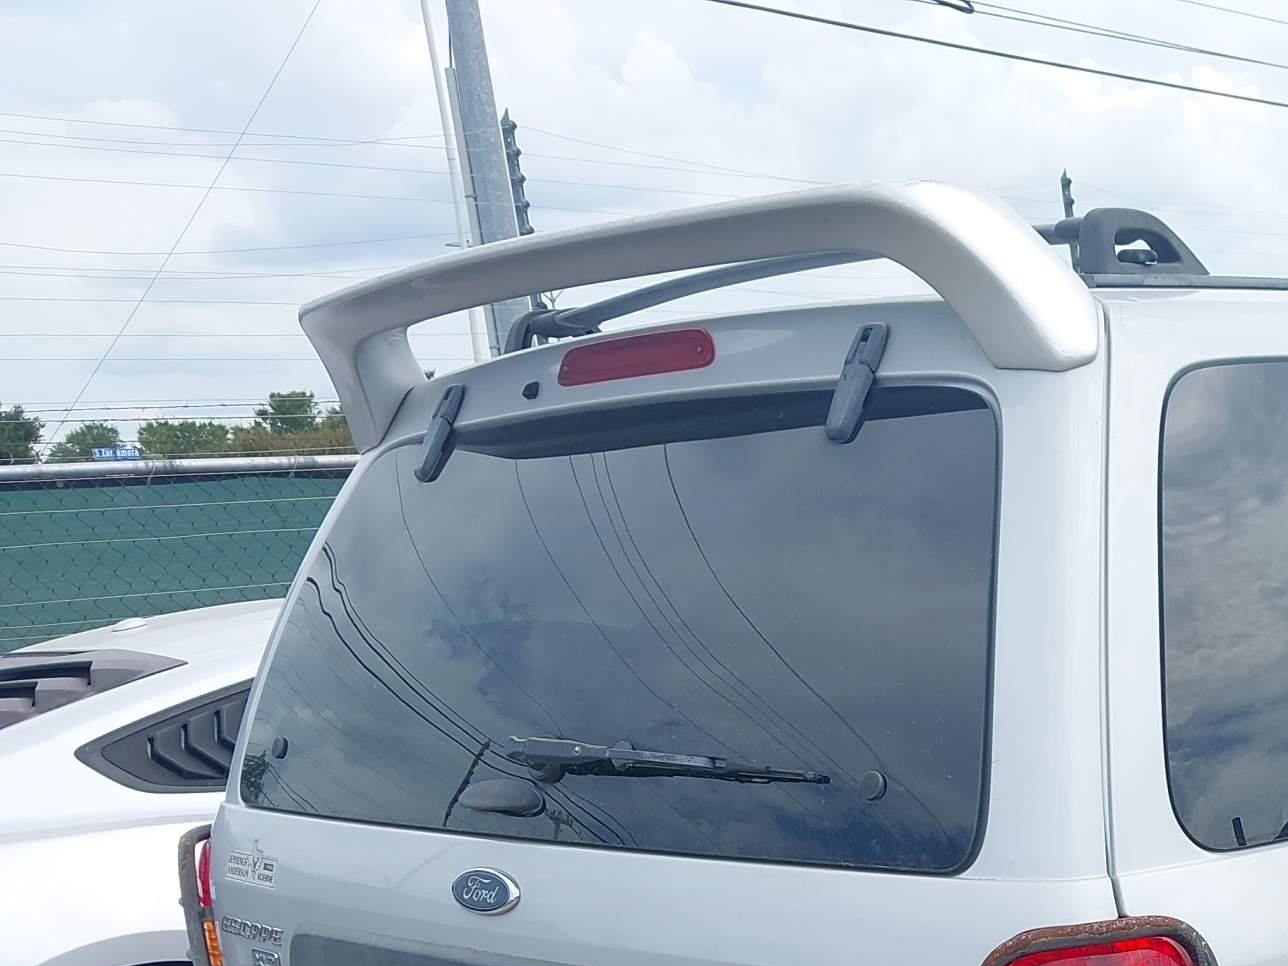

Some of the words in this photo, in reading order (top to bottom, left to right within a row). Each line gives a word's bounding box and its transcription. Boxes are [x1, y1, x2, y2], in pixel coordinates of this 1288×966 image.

[101, 448, 140, 457] Zaramora
[462, 875, 500, 904] Ford
[221, 915, 284, 947] ESCAPE
